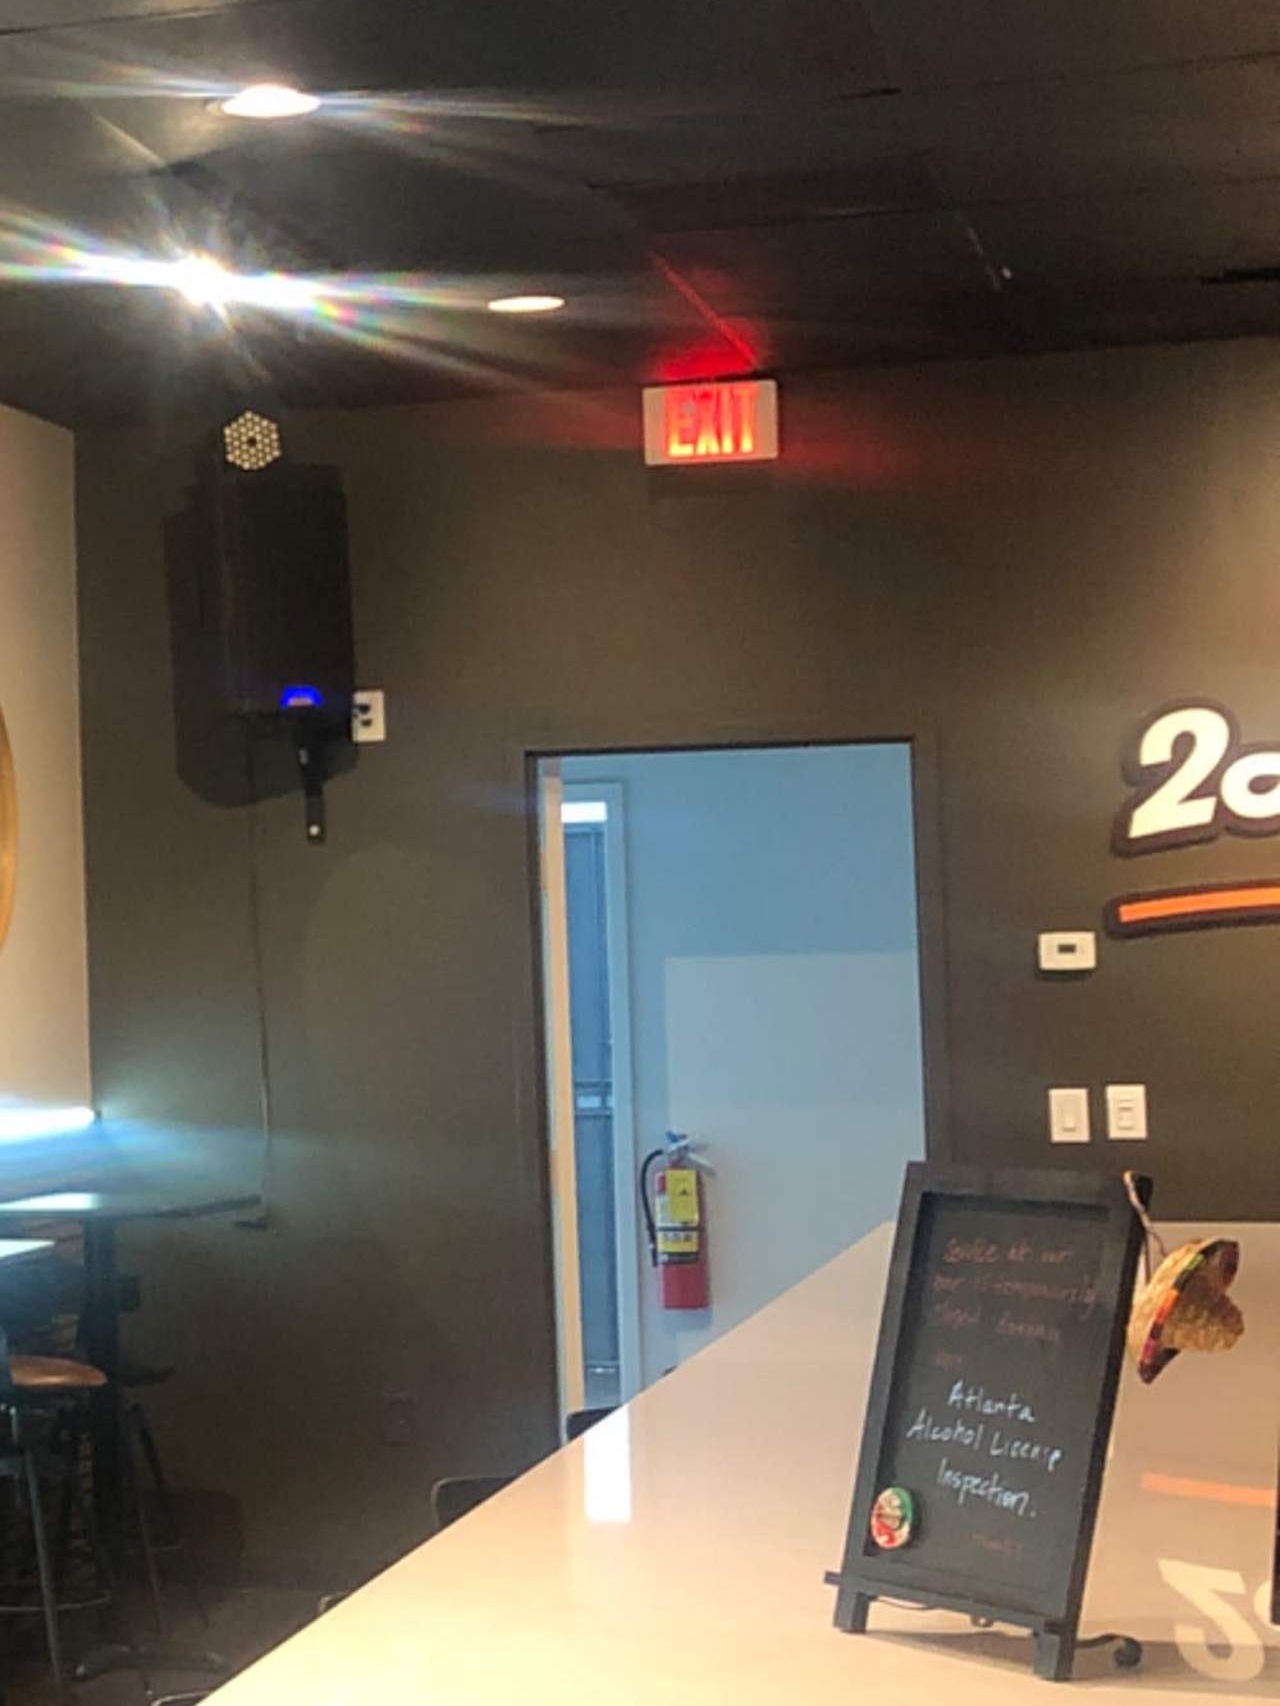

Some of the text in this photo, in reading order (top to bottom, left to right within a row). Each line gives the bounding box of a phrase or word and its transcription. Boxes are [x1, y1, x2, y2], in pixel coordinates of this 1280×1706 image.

[667, 383, 758, 457] EXIT
[947, 1379, 1036, 1423] Atlanta
[906, 1407, 984, 1450] Alcohol
